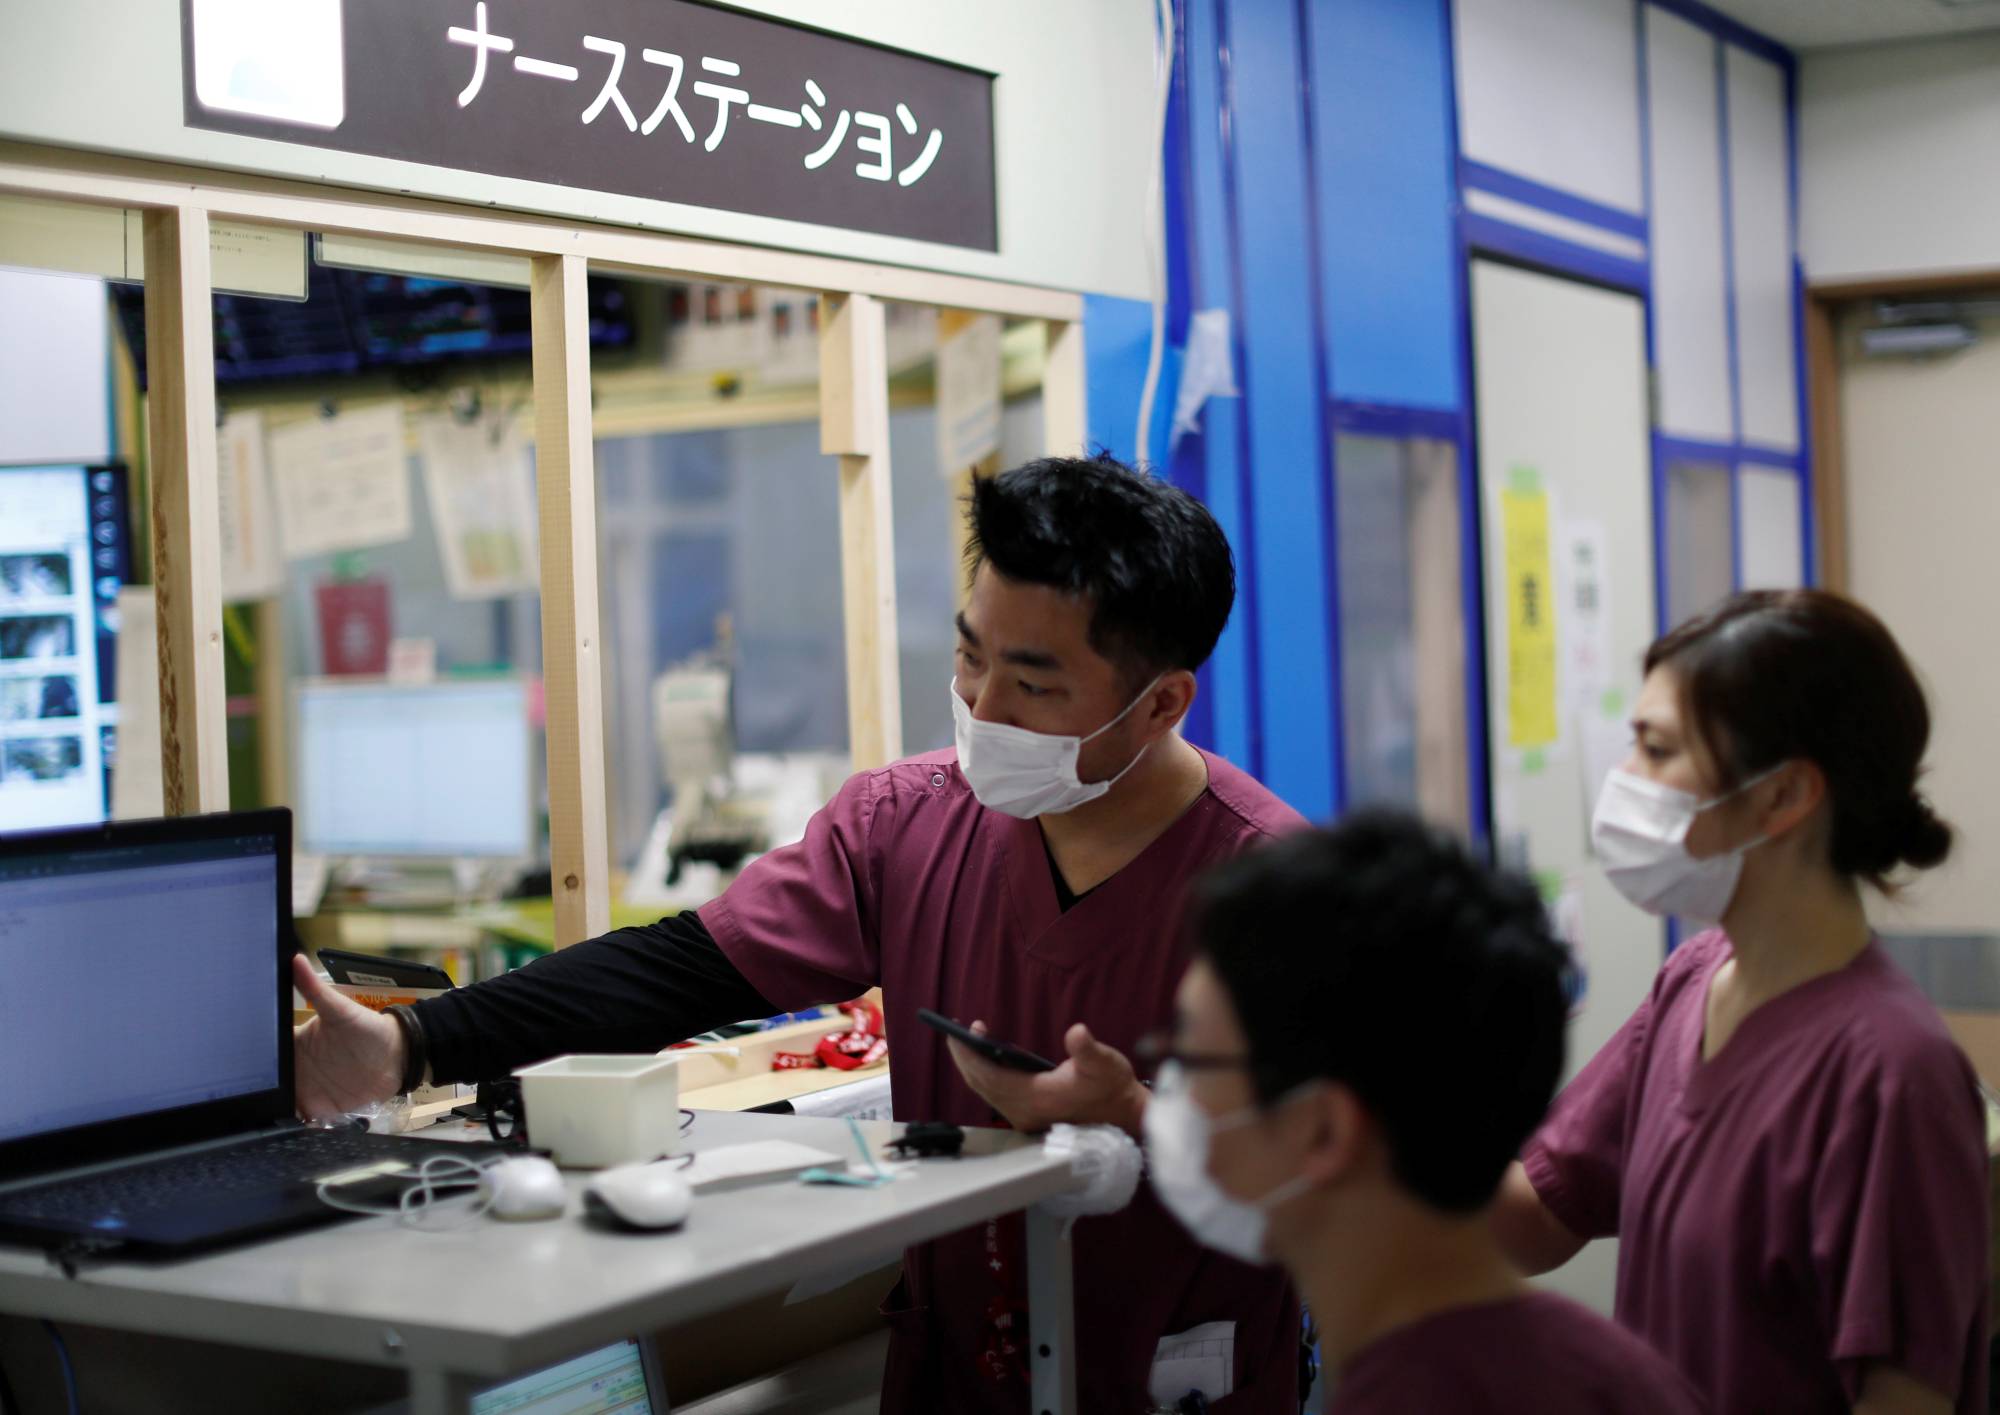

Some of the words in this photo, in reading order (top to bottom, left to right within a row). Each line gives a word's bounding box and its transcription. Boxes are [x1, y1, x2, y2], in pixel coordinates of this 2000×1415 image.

[448, 1, 943, 187] ナースステーション
